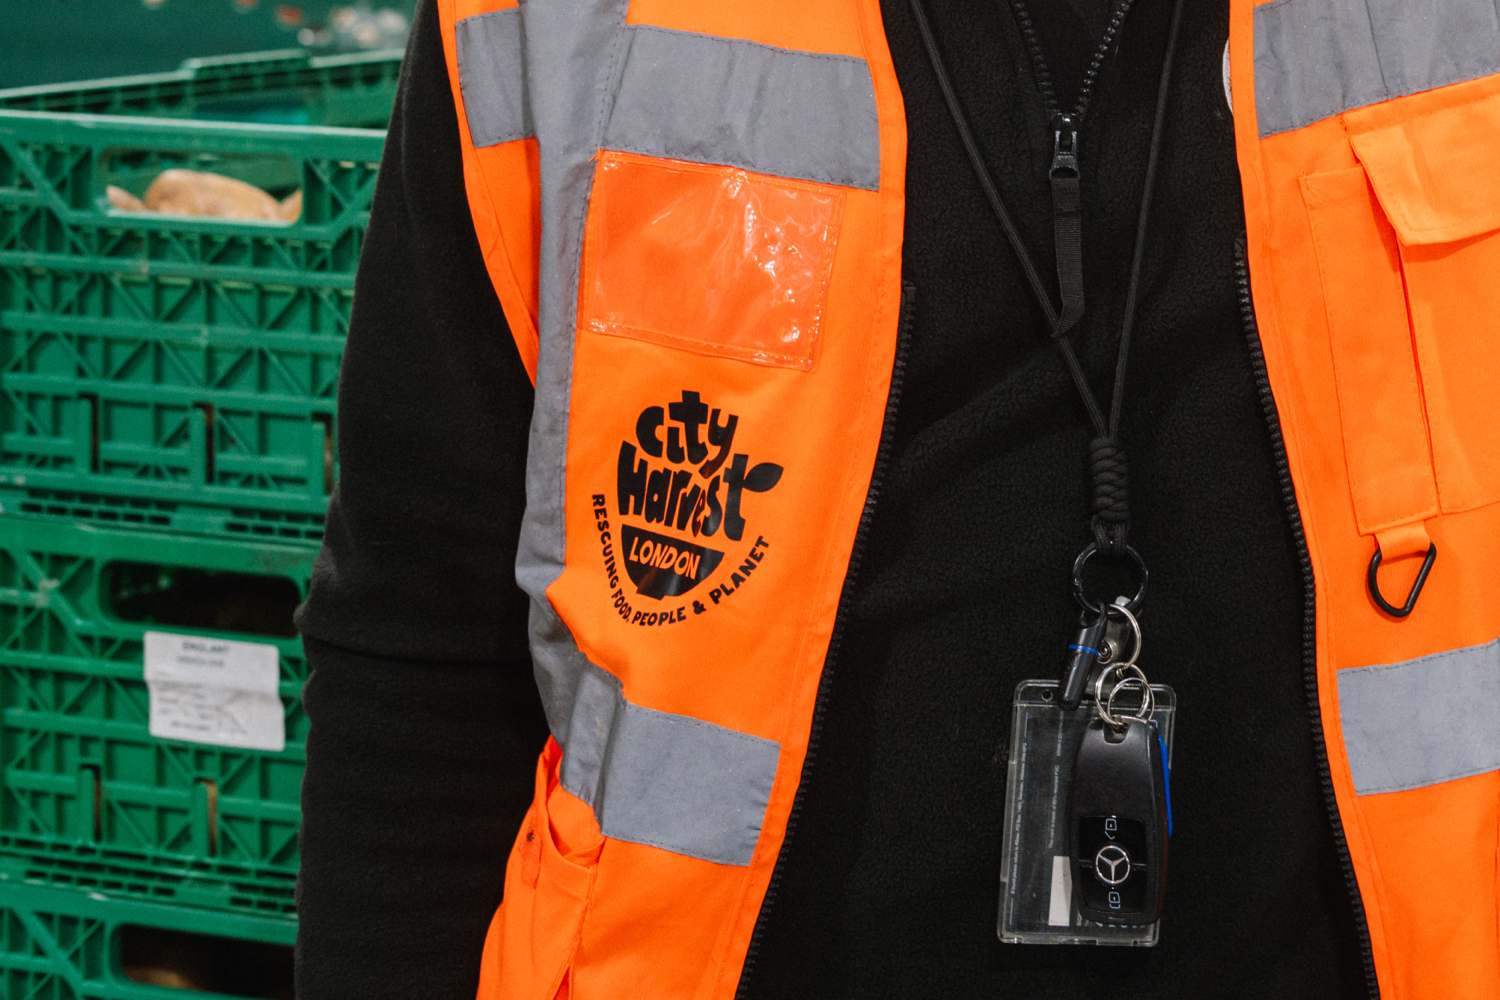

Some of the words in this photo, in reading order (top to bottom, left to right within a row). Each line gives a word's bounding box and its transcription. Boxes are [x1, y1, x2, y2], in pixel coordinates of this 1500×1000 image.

[636, 390, 739, 479] city
[617, 440, 749, 541] Harvest
[592, 494, 619, 589] RESCUING
[611, 588, 632, 623] FOOD,
[631, 606, 687, 626] PEOPLE
[692, 600, 707, 615] &
[709, 536, 770, 604] PLANET
[629, 537, 700, 579] LONDON
